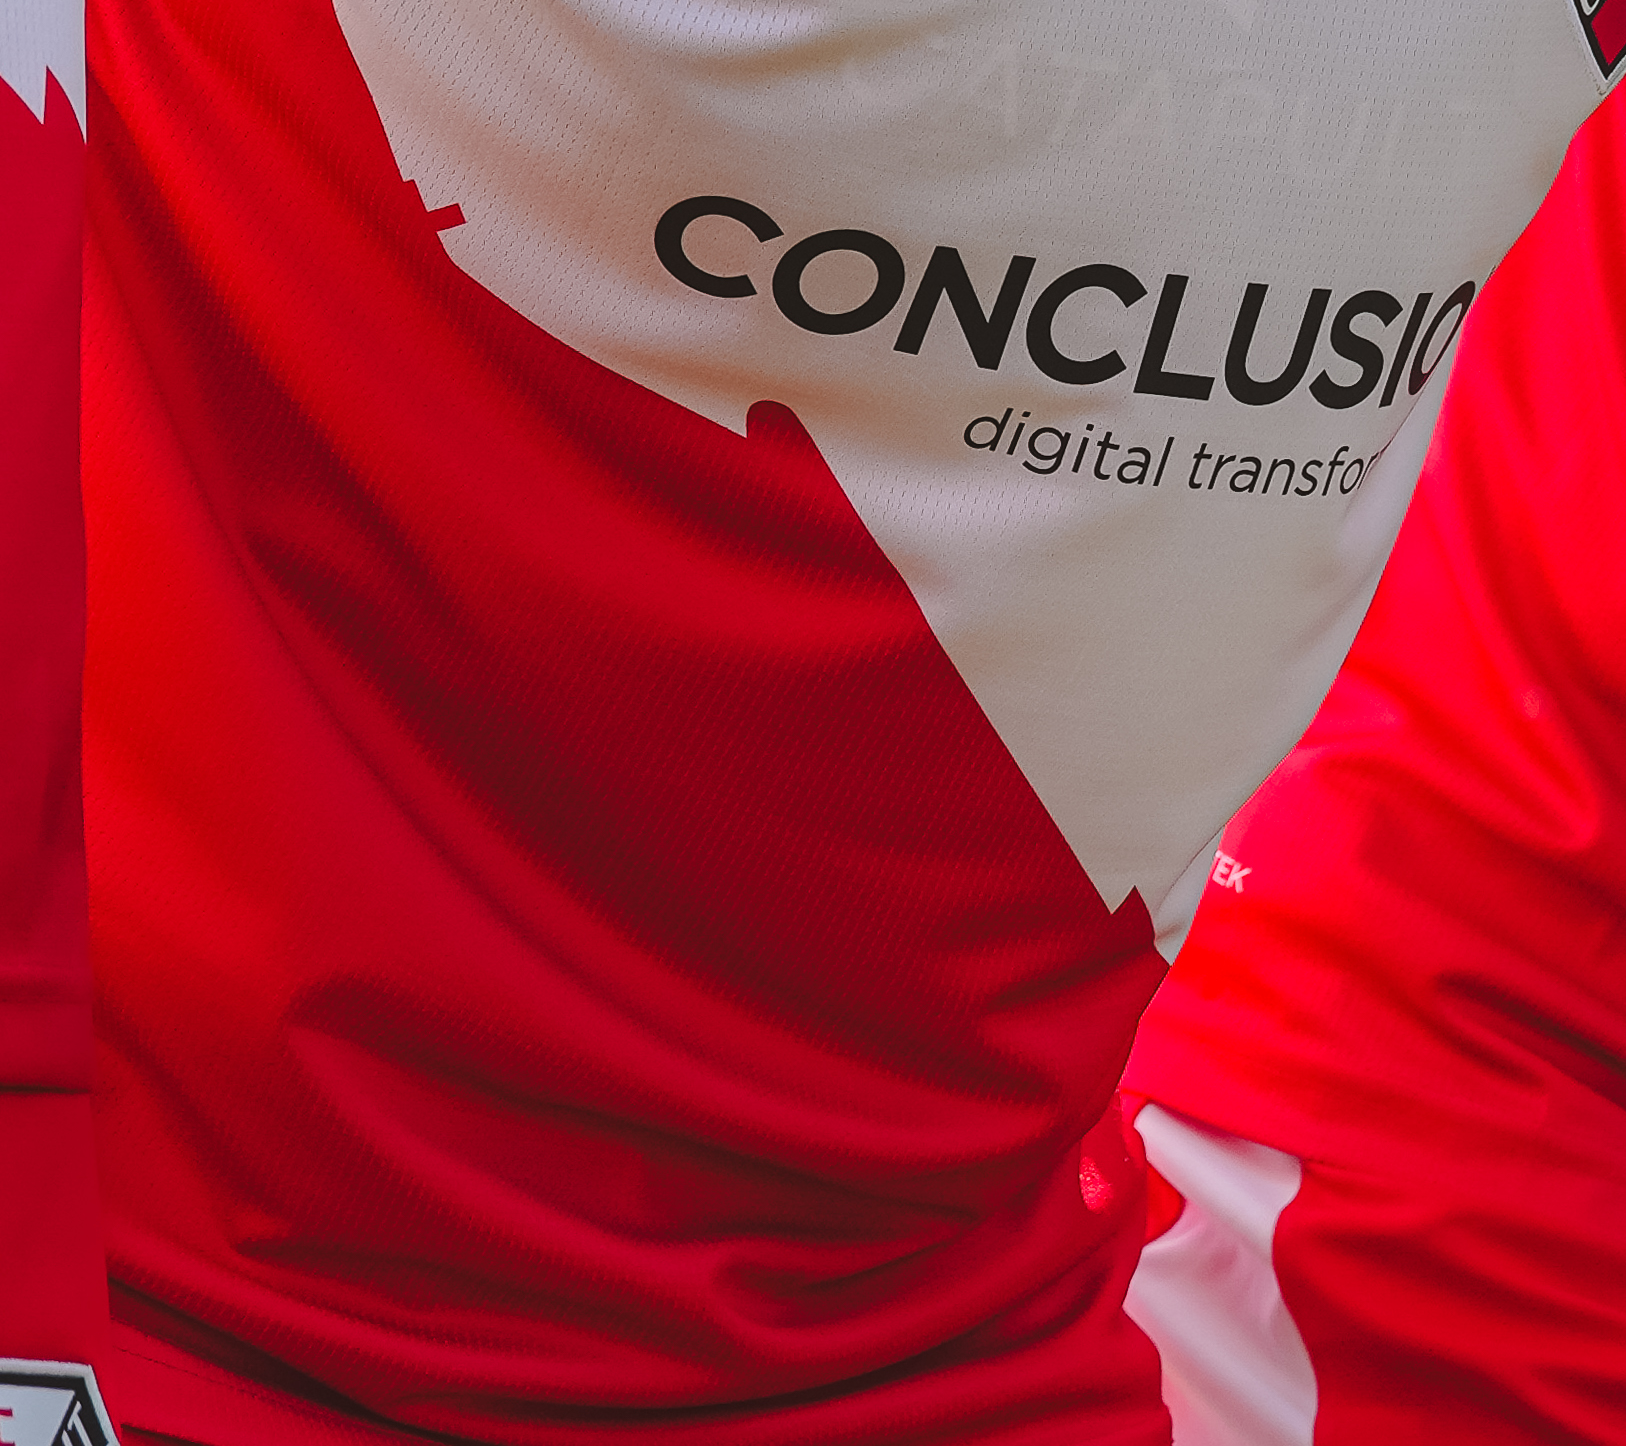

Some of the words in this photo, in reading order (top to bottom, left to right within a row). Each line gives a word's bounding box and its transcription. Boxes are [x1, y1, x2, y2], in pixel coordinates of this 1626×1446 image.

[654, 196, 1480, 409] CONCLUSIO
[964, 408, 1175, 488] digital
[1188, 440, 1391, 496] transfor
